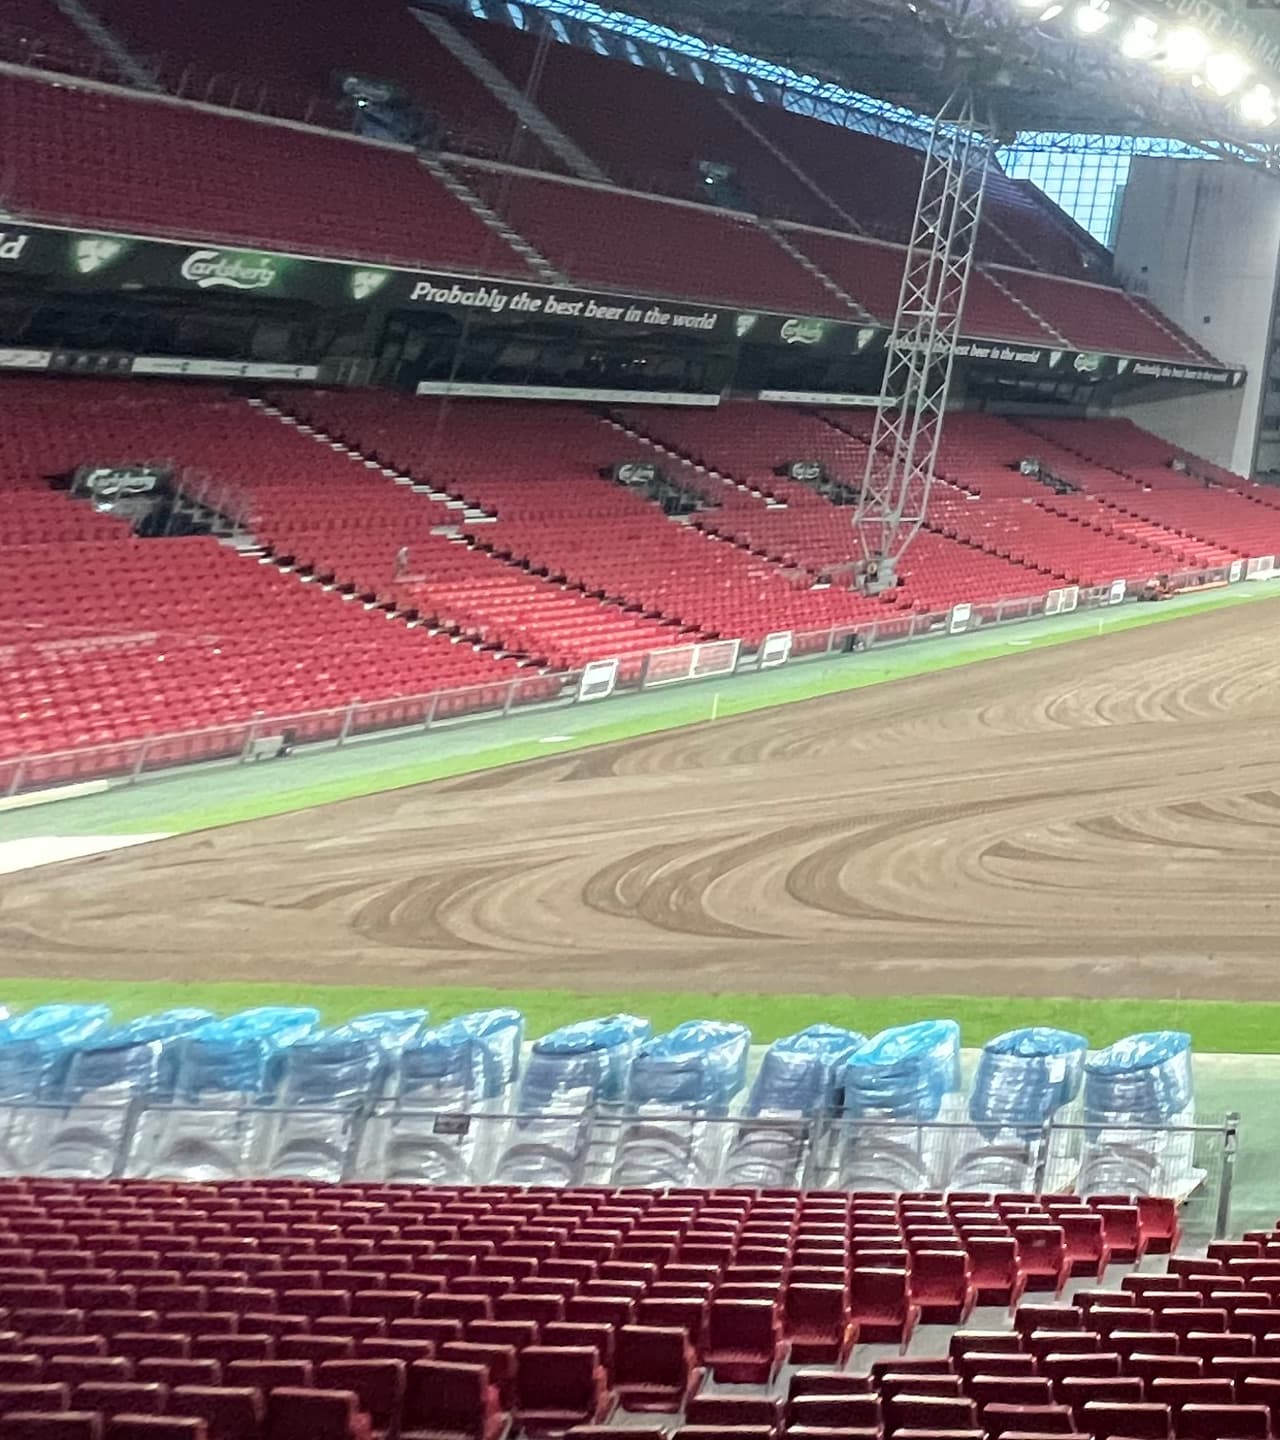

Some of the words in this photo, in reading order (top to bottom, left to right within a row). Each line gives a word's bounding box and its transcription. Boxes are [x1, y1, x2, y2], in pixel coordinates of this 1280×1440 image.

[181, 250, 277, 290] Carlsberg
[410, 282, 508, 313] Probably
[509, 291, 540, 312] the
[543, 295, 583, 316] best
[585, 300, 621, 321] beer
[624, 305, 642, 323] in
[644, 306, 671, 327] the
[673, 313, 718, 330] world
